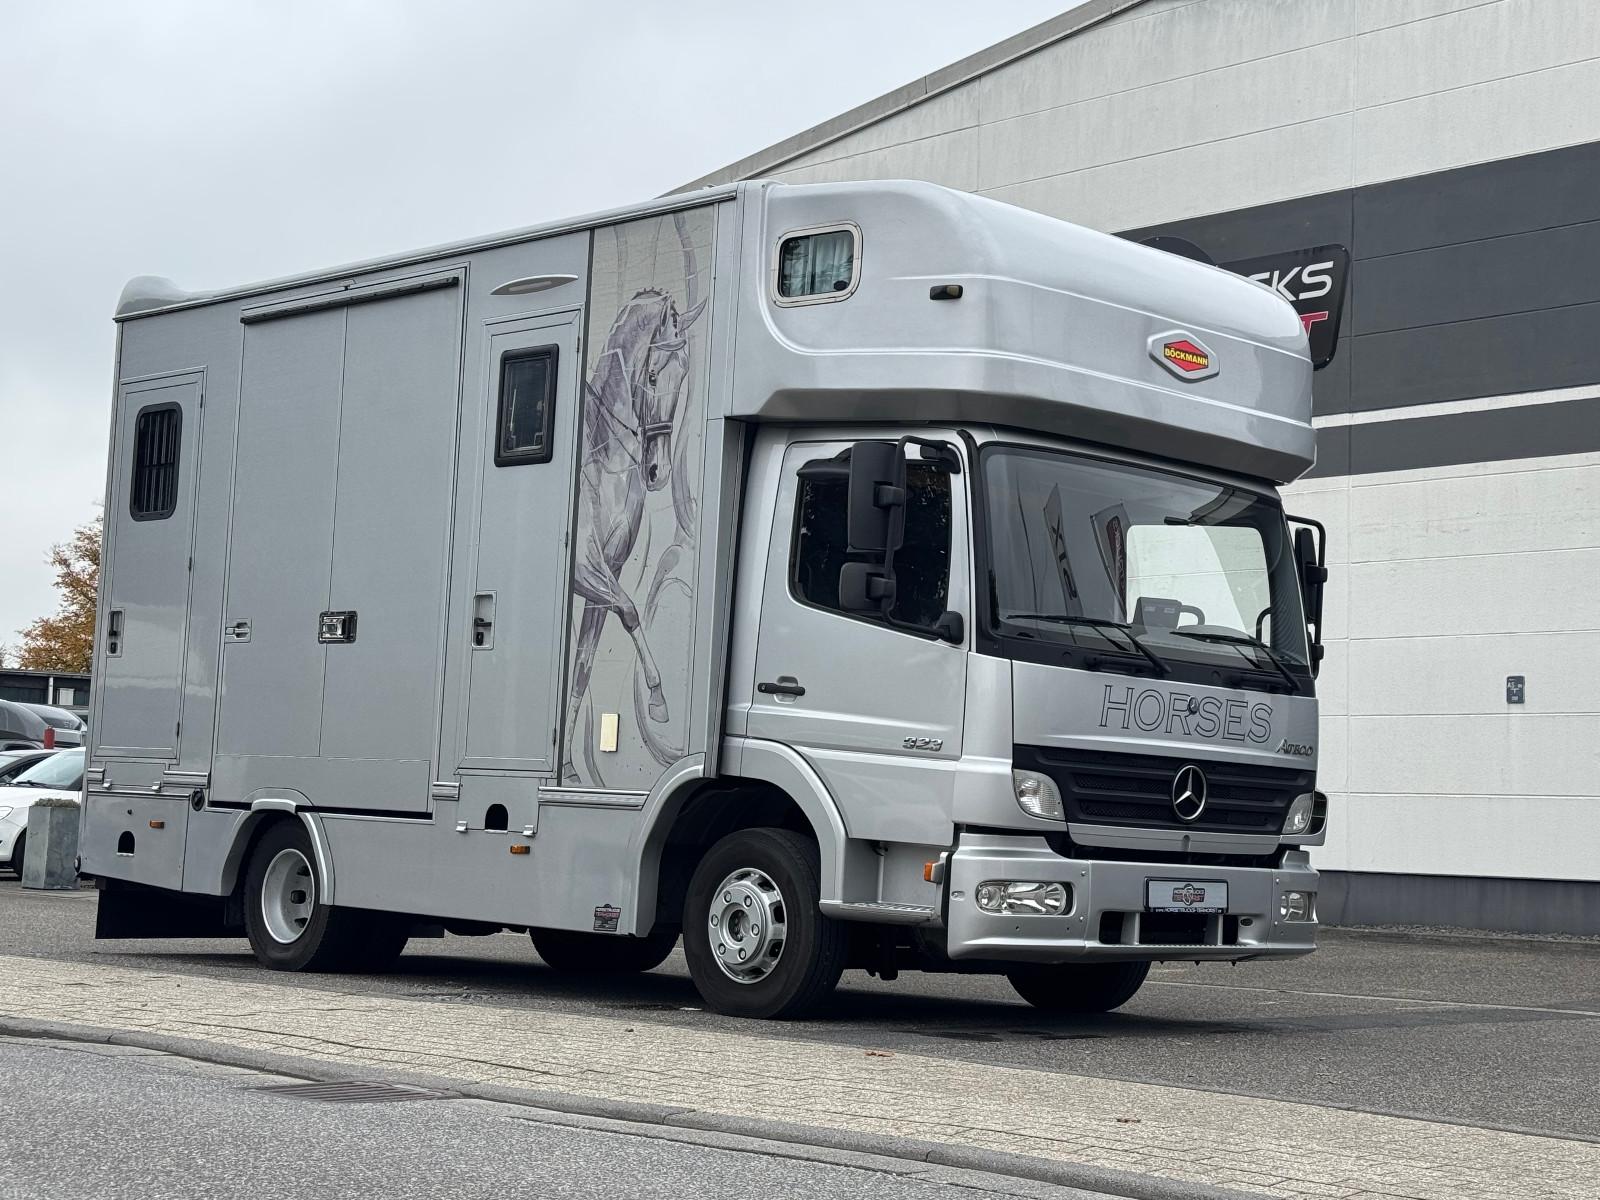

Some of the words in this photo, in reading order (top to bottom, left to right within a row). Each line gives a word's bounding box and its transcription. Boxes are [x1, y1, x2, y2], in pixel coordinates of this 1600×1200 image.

[1248, 260, 1334, 301] KS
[1164, 347, 1208, 366] BÖCKMANN
[1098, 684, 1273, 743] HORSES
